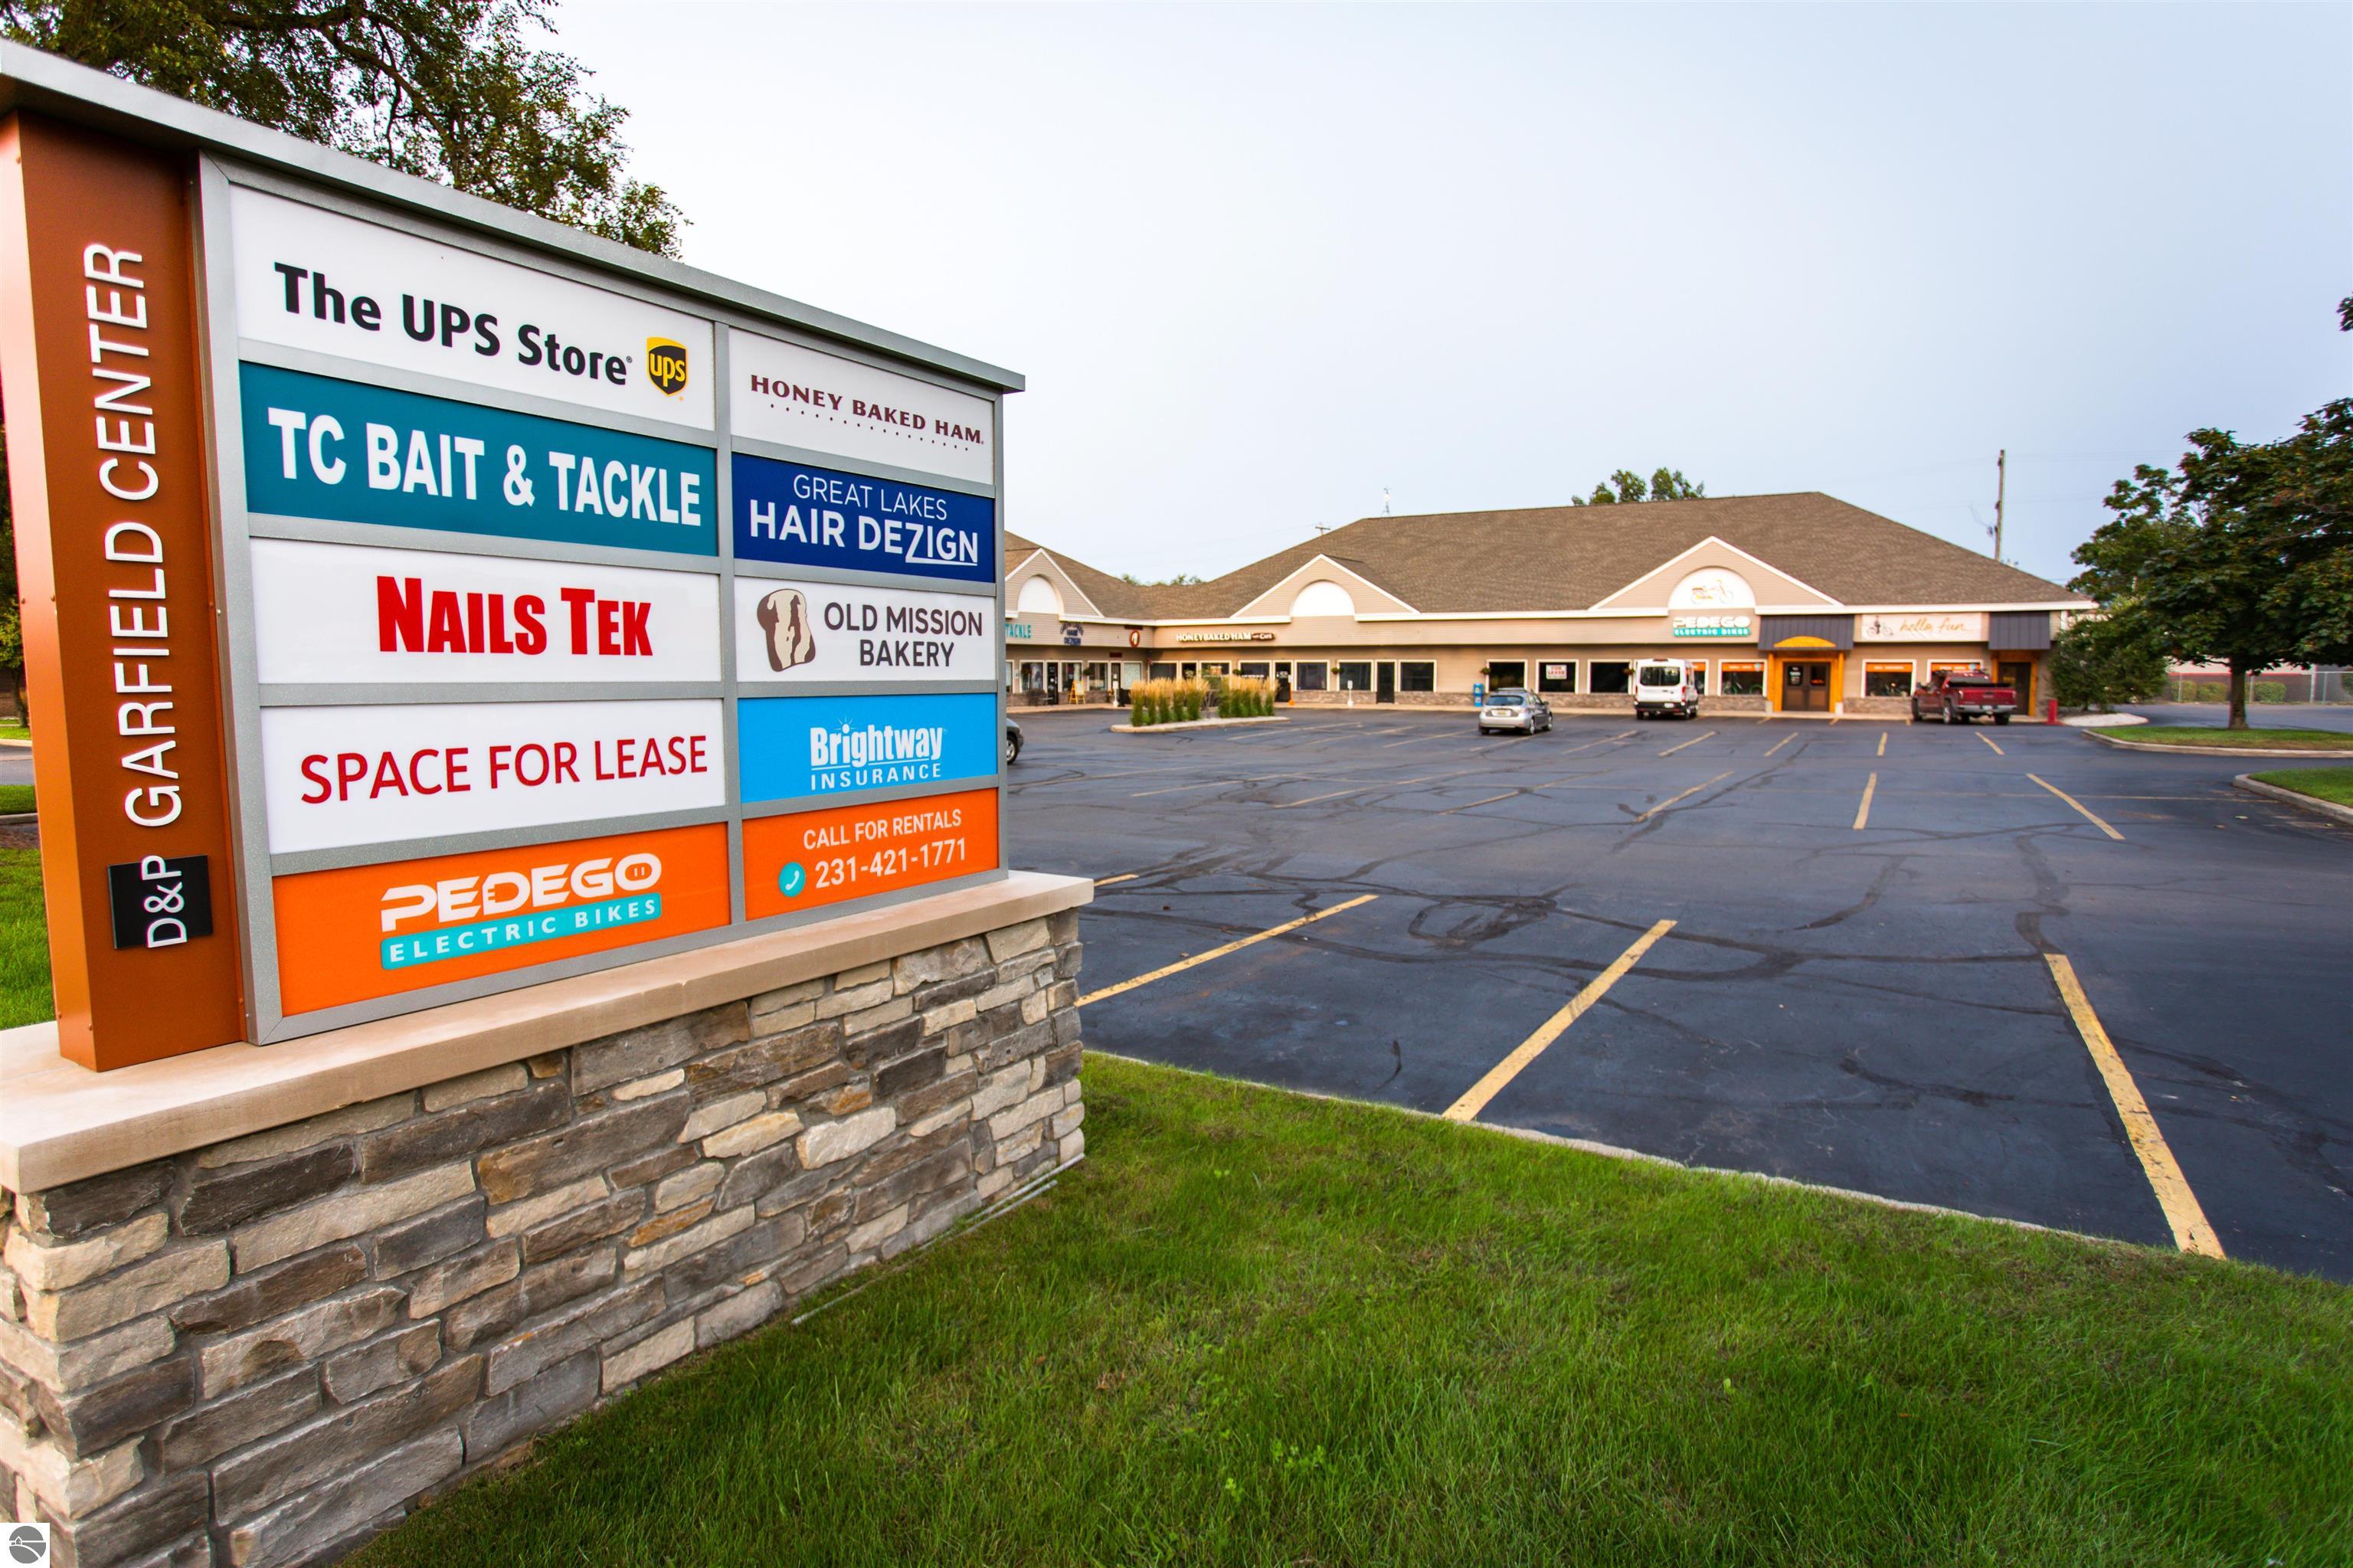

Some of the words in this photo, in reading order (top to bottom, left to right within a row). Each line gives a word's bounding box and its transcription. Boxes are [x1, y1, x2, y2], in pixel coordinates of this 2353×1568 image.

[273, 261, 381, 332] The
[401, 293, 500, 358] UPS
[83, 243, 160, 501] CENTER
[650, 352, 686, 388] ups
[751, 374, 843, 411] HONEY
[852, 399, 926, 430] BAKED
[267, 406, 347, 486] TC
[365, 421, 486, 501] BAIT
[502, 444, 535, 508] &
[548, 450, 702, 526] TACKLE
[793, 473, 874, 508] GREAT
[880, 490, 947, 521] LAKES
[749, 499, 846, 548] HAIR
[858, 516, 979, 567] DEZIGN
[376, 575, 548, 656] NAILS
[560, 587, 653, 656] TEK
[823, 601, 878, 633] OLD
[886, 605, 983, 637] MISSION
[104, 522, 182, 827] GARFIELD
[859, 638, 955, 668] BAKERY
[299, 747, 471, 804] SPACE
[489, 741, 580, 789] FOR
[594, 735, 708, 781] LEASE
[810, 723, 943, 768] Brightway
[810, 762, 941, 791] INSURANCE
[803, 823, 850, 850] CALL
[854, 820, 888, 842] FOR
[892, 808, 962, 838] RENTALS
[380, 852, 663, 932] PEDEGO
[814, 836, 966, 890] 231-421-1771
[140, 854, 188, 948] D&P
[389, 916, 556, 963] ELECTRIC
[574, 899, 655, 928] BIKES
